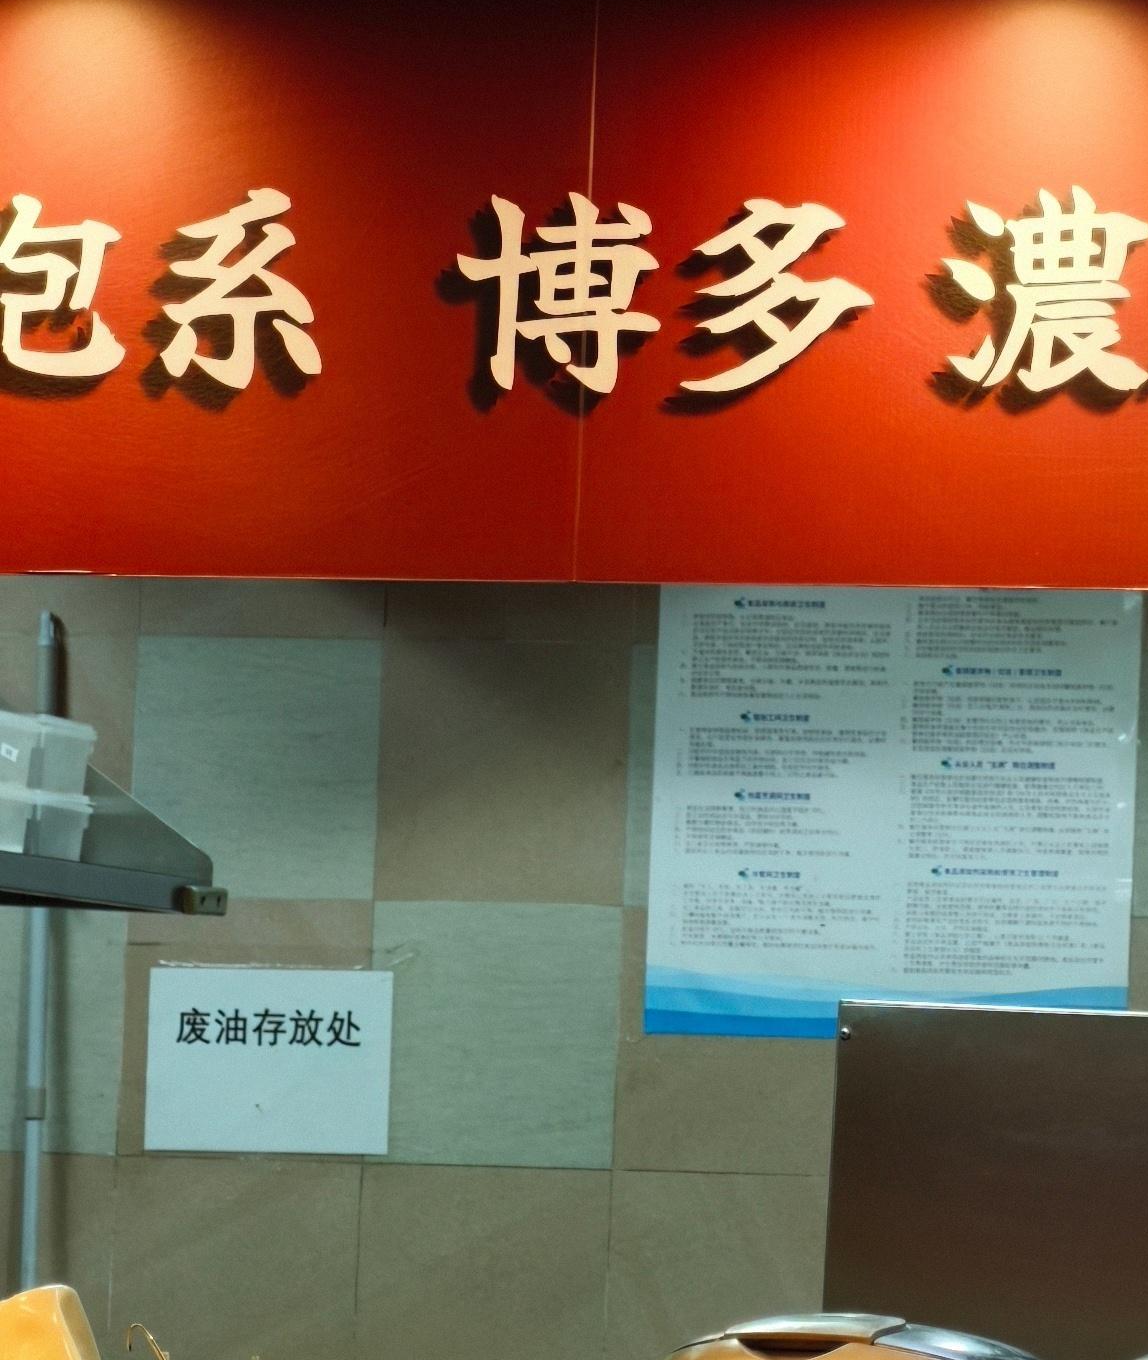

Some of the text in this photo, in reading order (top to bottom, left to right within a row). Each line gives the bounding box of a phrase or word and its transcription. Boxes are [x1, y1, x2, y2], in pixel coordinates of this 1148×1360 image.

[456, 191, 876, 394] 博多
[176, 1007, 362, 1047] 废油存放处
